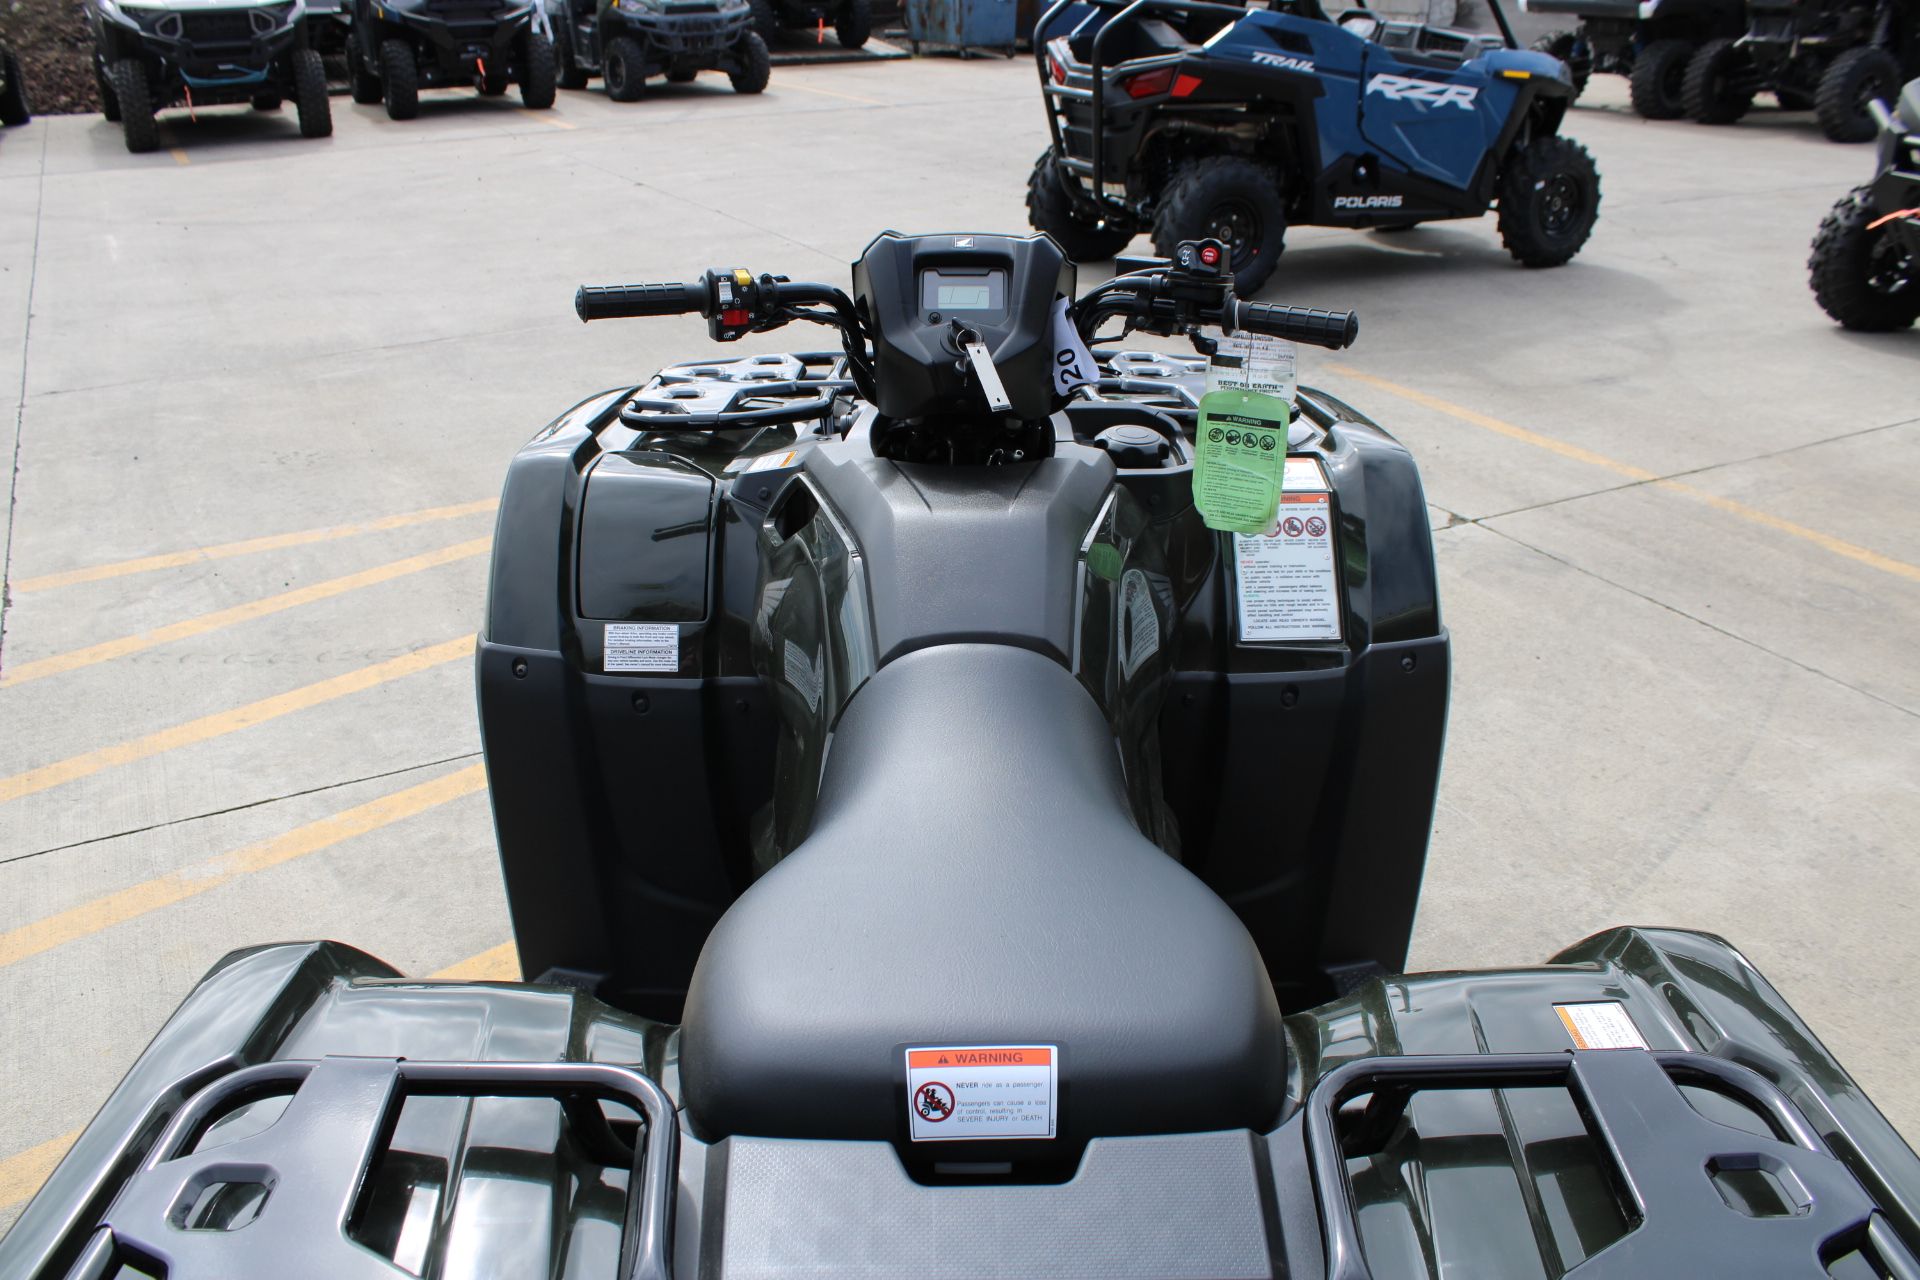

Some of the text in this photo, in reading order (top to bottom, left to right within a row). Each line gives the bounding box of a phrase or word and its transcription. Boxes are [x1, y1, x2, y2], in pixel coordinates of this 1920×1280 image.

[1251, 51, 1315, 72] TRAIL
[1366, 73, 1479, 110] RZR
[1334, 195, 1402, 208] POLARIS
[1218, 379, 1238, 387] BEST
[1232, 416, 1262, 426] WARNING
[955, 1053, 1023, 1064] WARNING
[989, 1107, 1014, 1115] resulting
